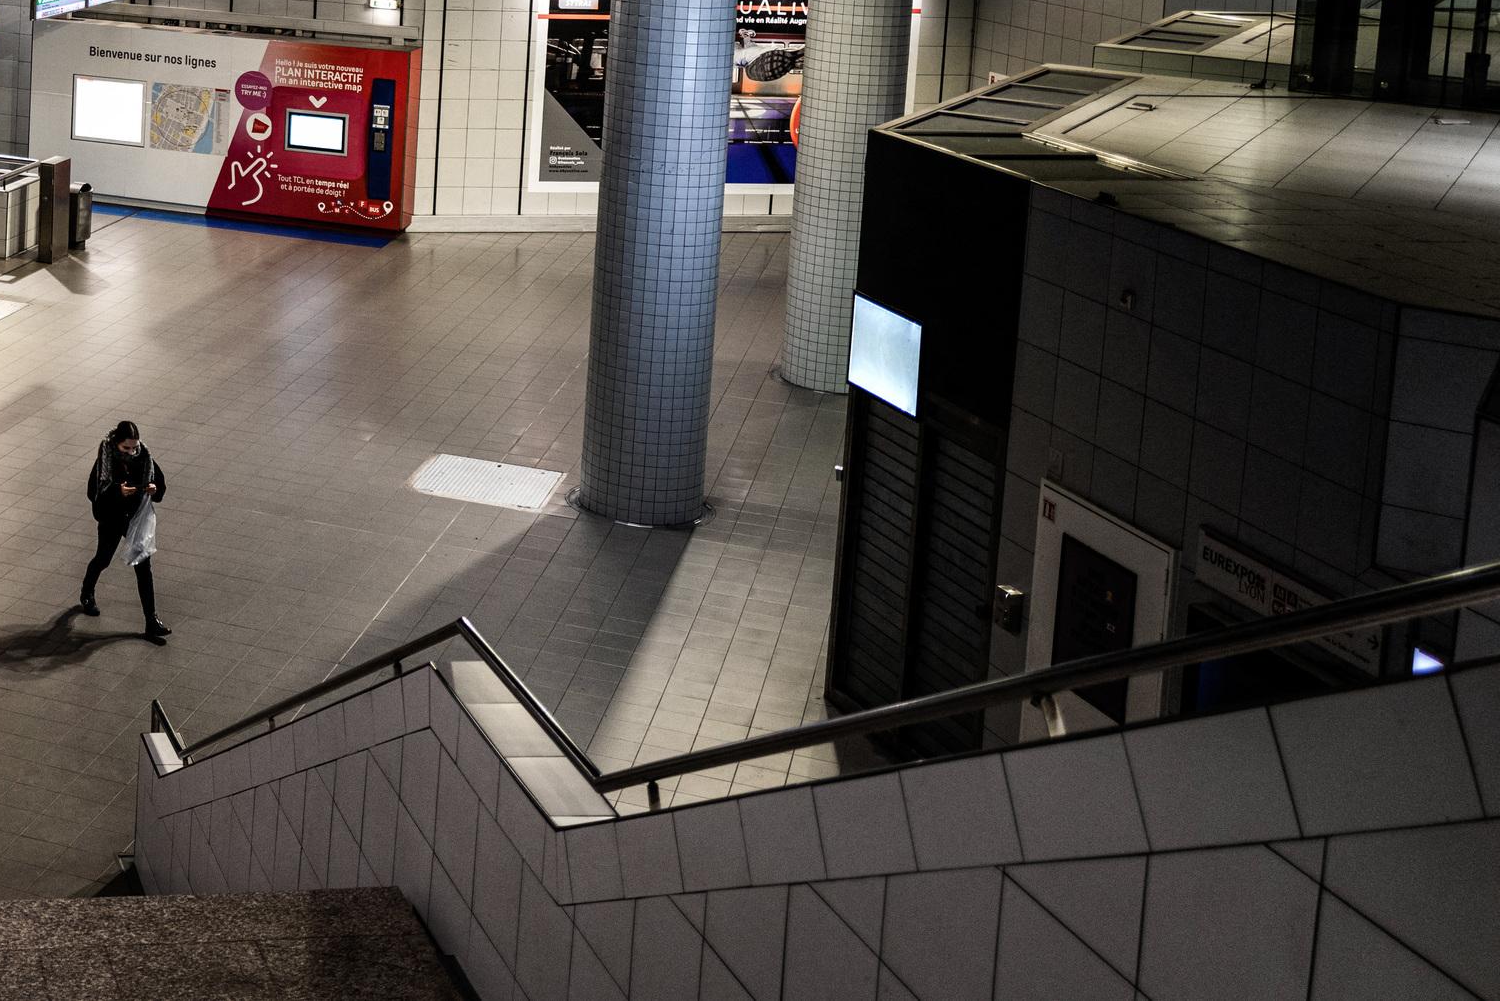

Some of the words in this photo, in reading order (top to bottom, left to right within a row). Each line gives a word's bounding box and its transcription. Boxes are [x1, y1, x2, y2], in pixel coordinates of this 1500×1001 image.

[89, 46, 142, 61] Bienvenue
[145, 53, 161, 63] sur
[164, 55, 182, 65] nos
[185, 55, 217, 69] lignes
[275, 58, 292, 66] Hello
[304, 61, 317, 69] suis
[318, 63, 335, 71] votre
[336, 65, 363, 73] nouveau
[275, 66, 301, 77] PLAN
[304, 69, 363, 83] INTERACTIF
[300, 78, 343, 90] interactive
[344, 84, 362, 93] map
[277, 174, 291, 182] Tout
[293, 175, 305, 184] TCL
[315, 179, 335, 188] temps
[336, 180, 349, 189] réel
[288, 183, 292, 191] à
[293, 185, 315, 194] portée
[315, 187, 324, 195] de
[325, 189, 342, 198] doigt
[1202, 546, 1256, 585] EUREXPO
[1238, 581, 1265, 603] LYON
